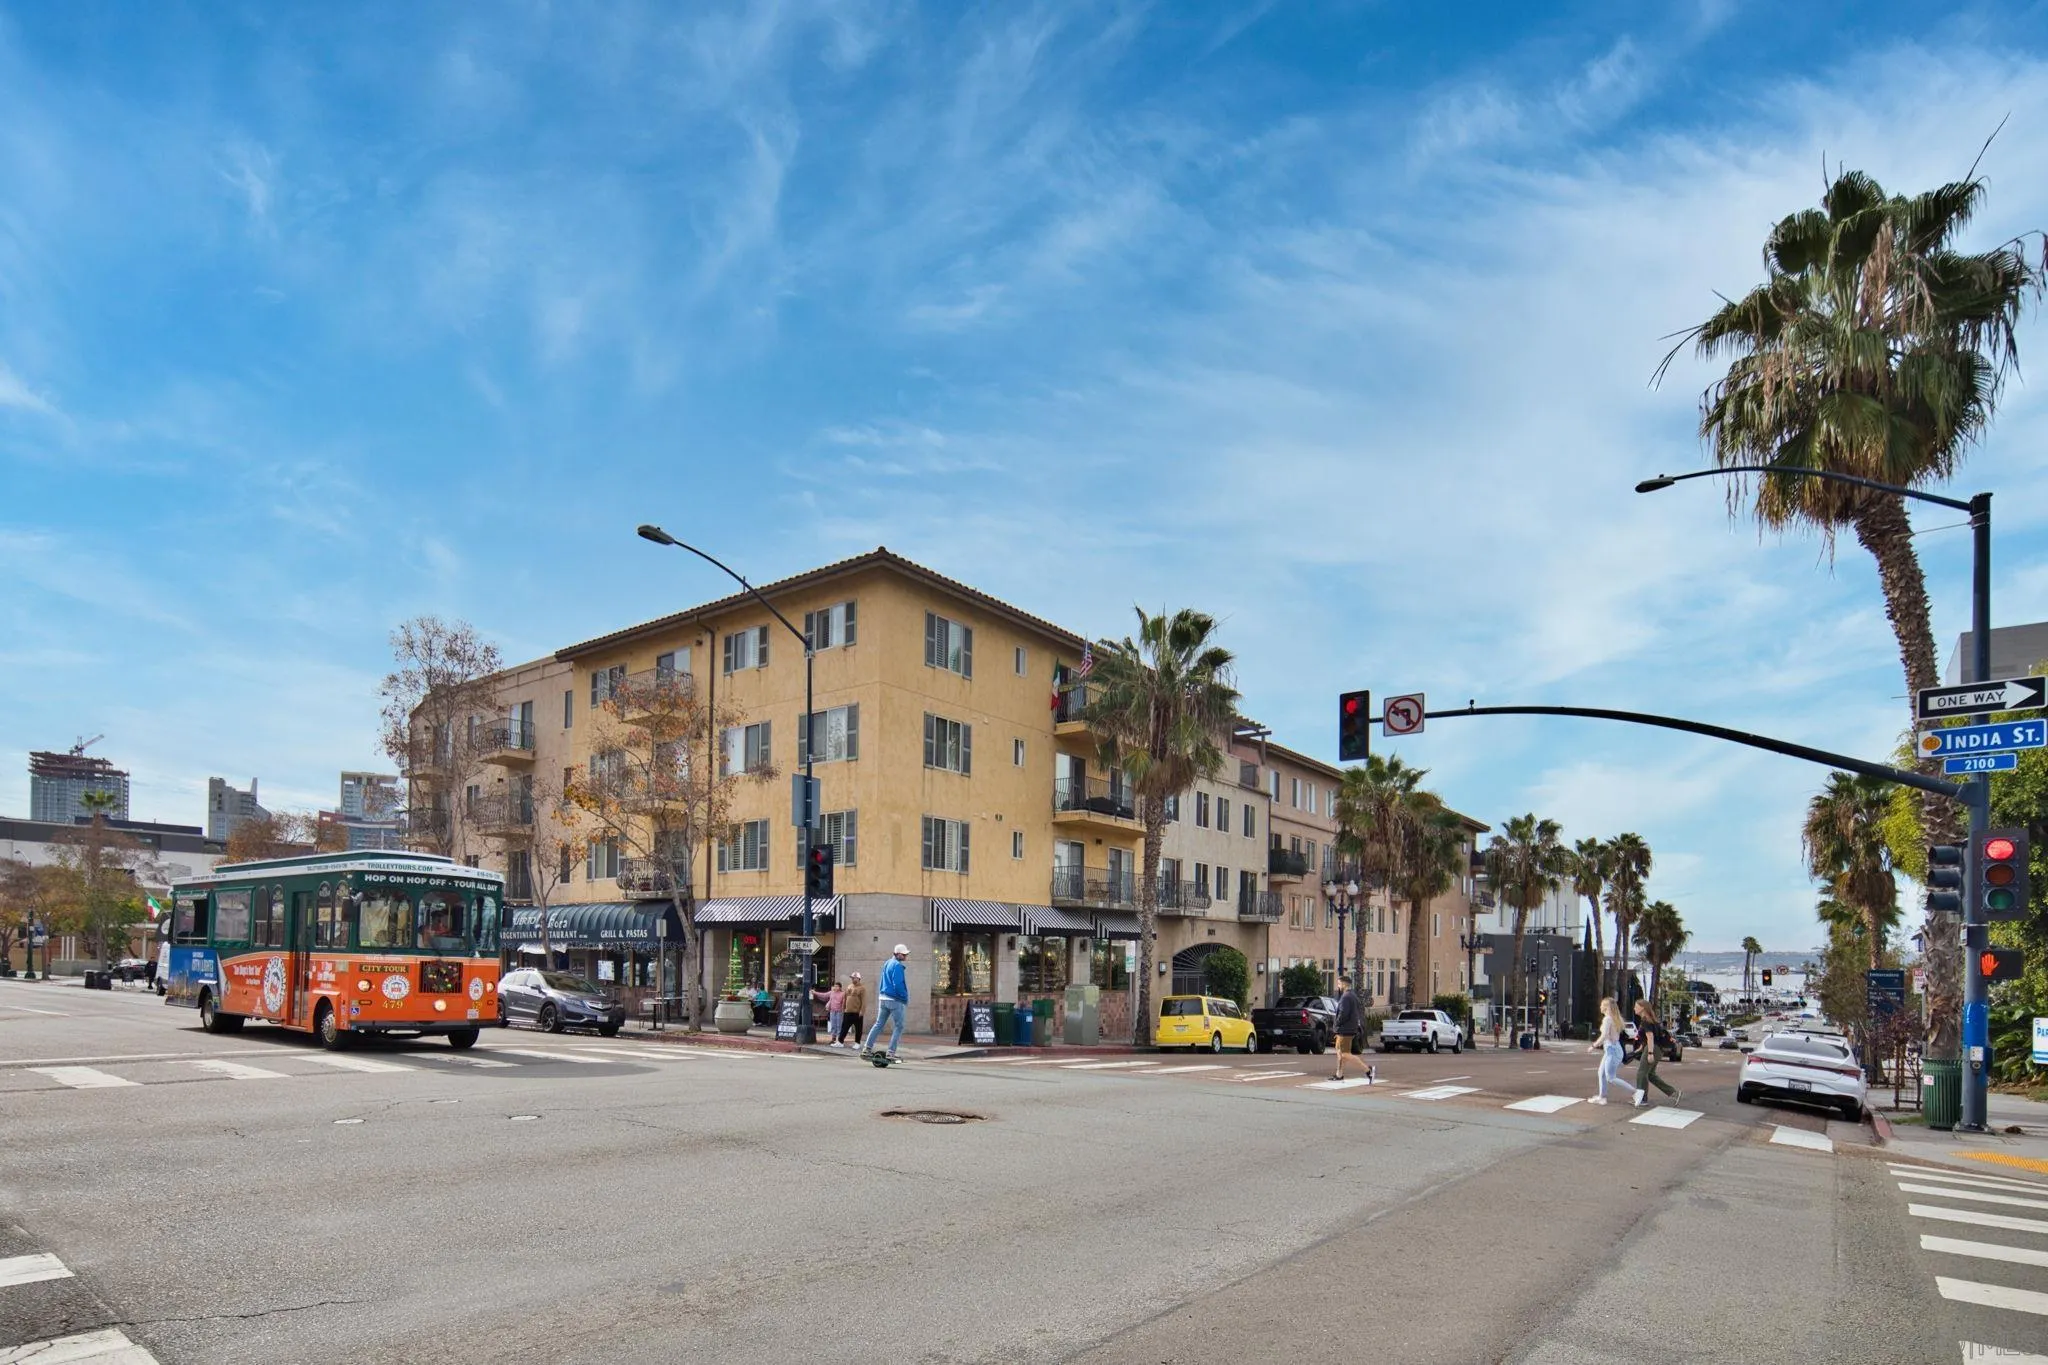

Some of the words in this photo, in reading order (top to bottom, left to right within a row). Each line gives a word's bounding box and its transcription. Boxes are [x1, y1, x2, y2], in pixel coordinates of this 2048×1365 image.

[1937, 694, 1967, 708] ONE
[1974, 690, 2005, 704] WAY
[1946, 732, 2002, 750] INDIA
[1964, 758, 1996, 771] 2100
[367, 862, 433, 872] TROLLEYTOURS.COM
[364, 874, 387, 882] HOP
[389, 875, 404, 883] ON
[406, 875, 427, 884] HOP
[429, 878, 447, 886] OFF
[454, 880, 476, 889] TOUR
[476, 882, 487, 890] ALL
[487, 884, 498, 892] DAY
[513, 916, 537, 926] UERTO
[600, 930, 617, 938] GRILL
[618, 930, 624, 938] &
[626, 929, 648, 938] PASTAS
[362, 964, 381, 972] CITY
[383, 1000, 404, 1009] 479
